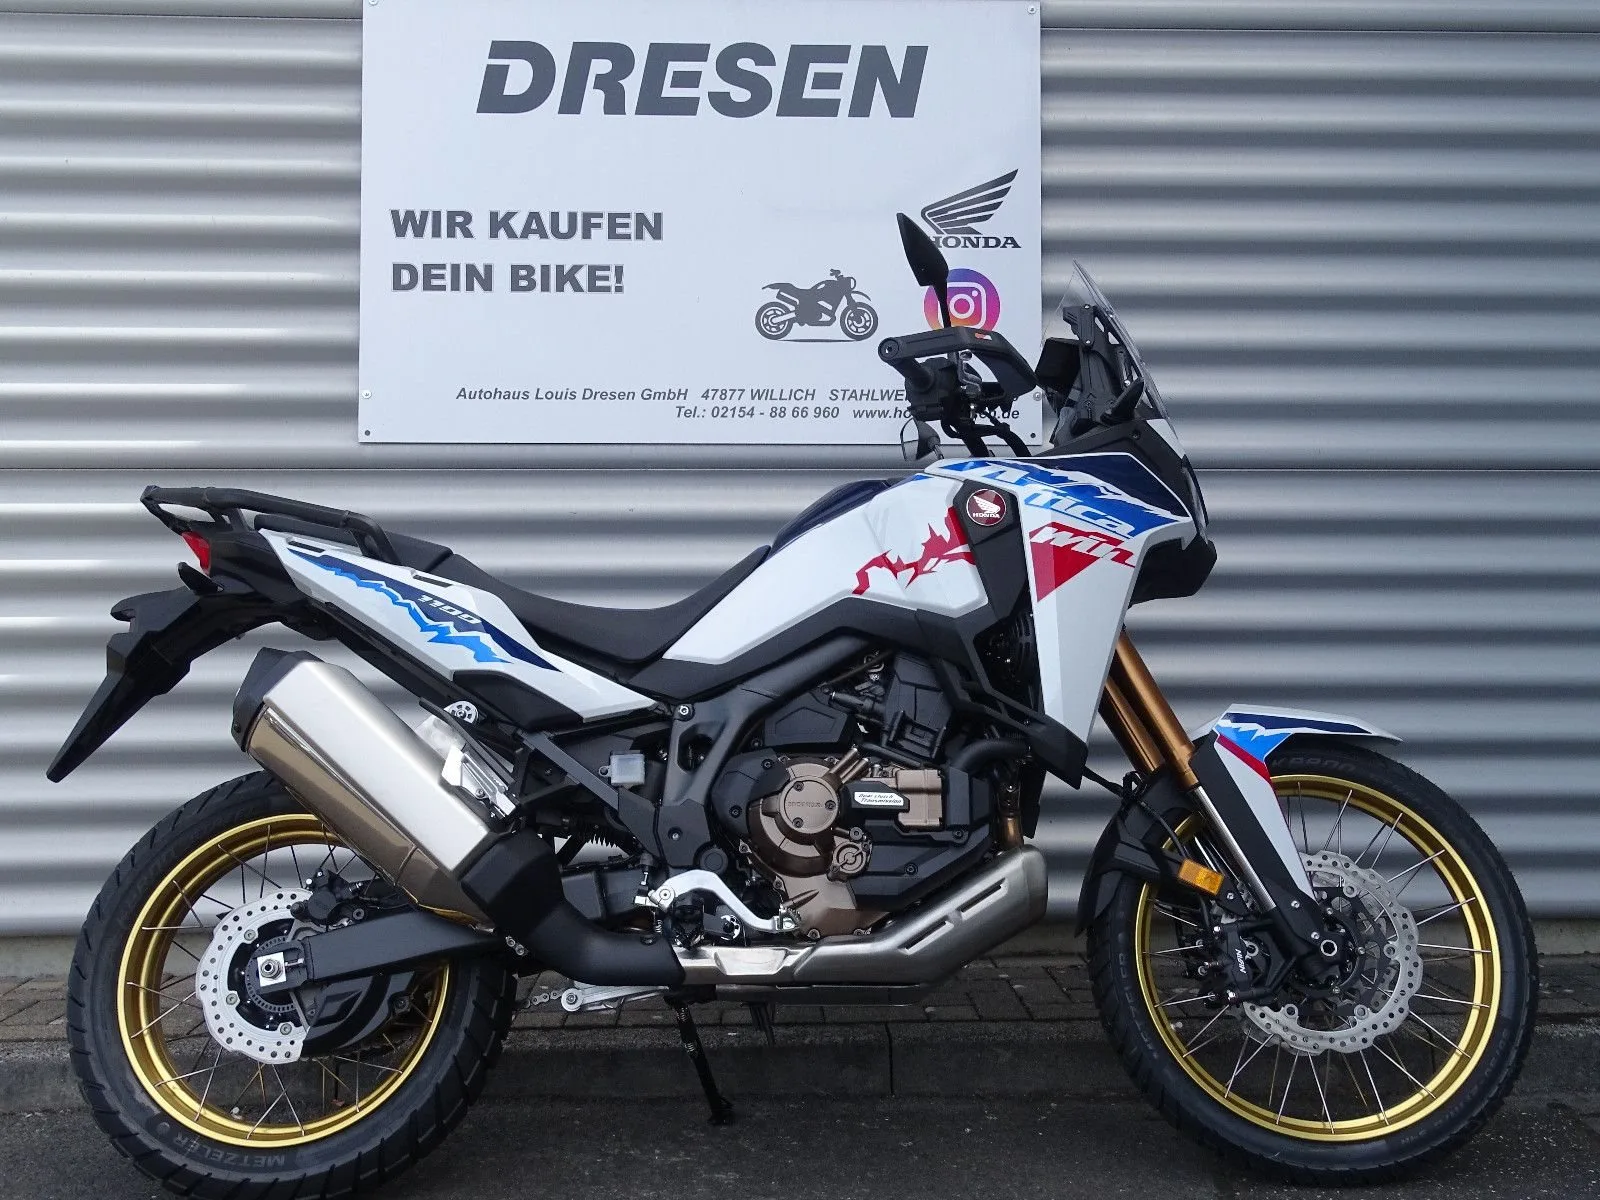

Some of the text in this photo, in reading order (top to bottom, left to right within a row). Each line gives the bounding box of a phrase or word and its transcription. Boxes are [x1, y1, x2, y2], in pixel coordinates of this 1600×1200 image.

[477, 40, 929, 118] DRESEN
[390, 209, 663, 241] WIR KAUFEN
[392, 263, 624, 293] DEIN BIKE!
[455, 387, 906, 401] Autohaus Louis Dresen GmbH 47877 WILLICH STAHLWE
[675, 406, 706, 418] Tel.:
[711, 406, 755, 419] 02154
[769, 406, 787, 419] 88
[791, 406, 809, 419] 66
[813, 406, 840, 419] 960
[418, 594, 482, 624] 1100
[174, 1131, 286, 1168] METZELER
